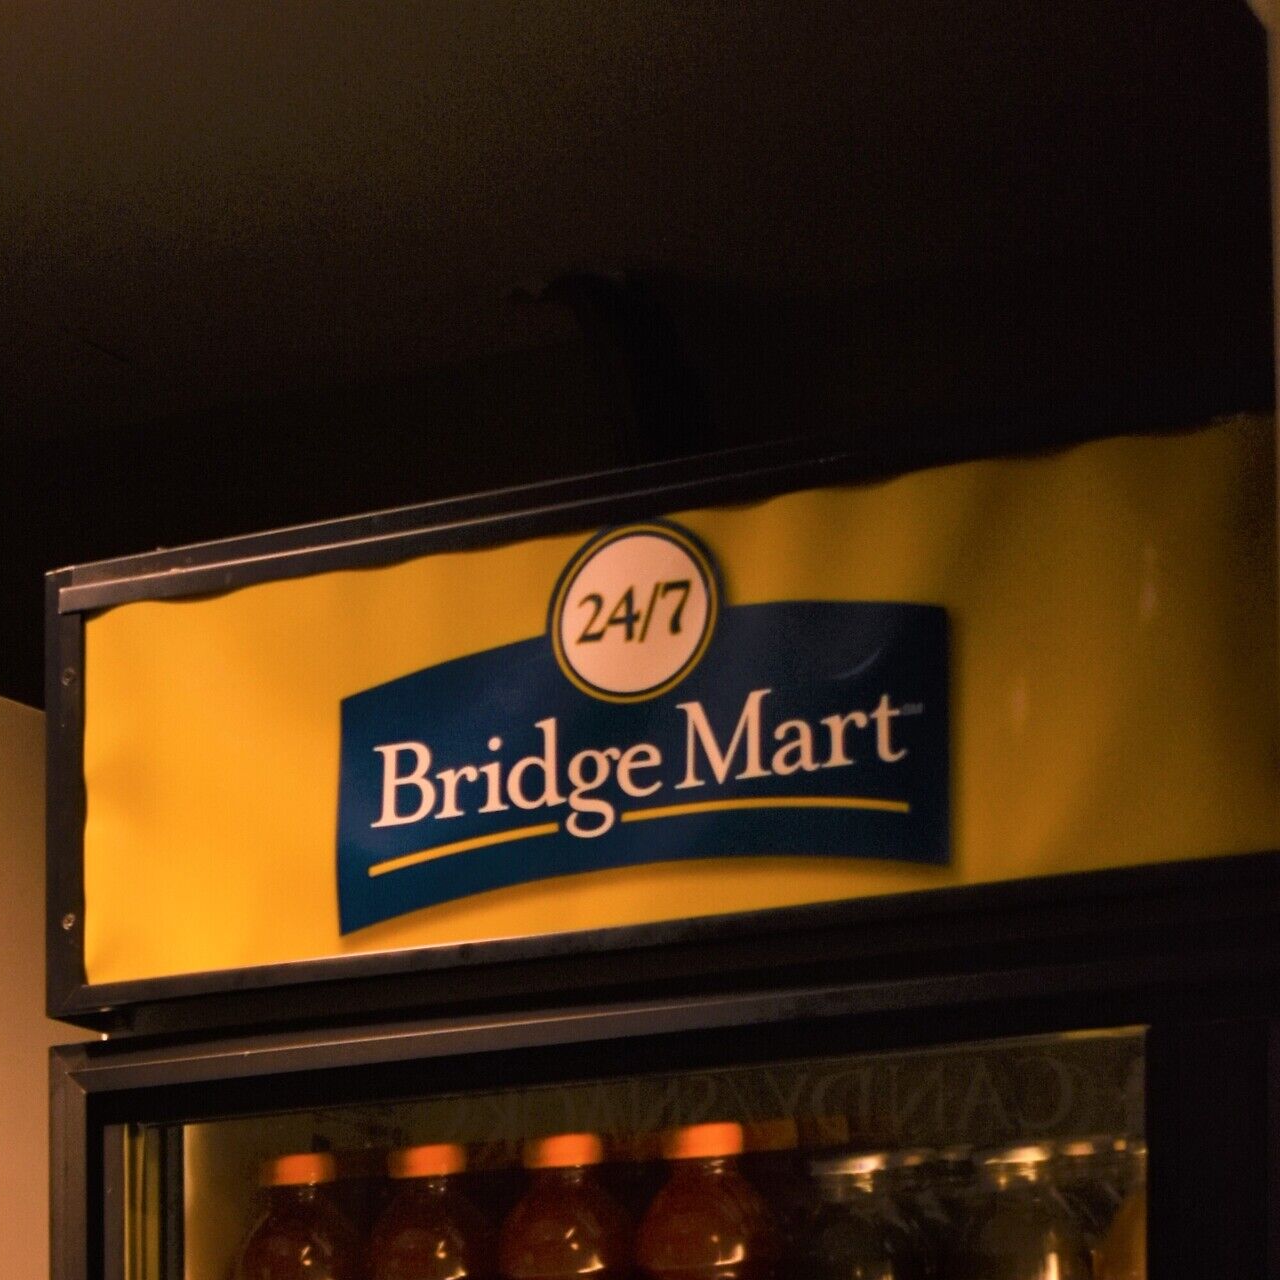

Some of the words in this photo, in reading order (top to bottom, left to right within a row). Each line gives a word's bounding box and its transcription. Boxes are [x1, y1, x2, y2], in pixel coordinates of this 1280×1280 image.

[575, 580, 693, 645] 24/7
[371, 718, 664, 839] Bridge
[673, 689, 908, 790] Mart
